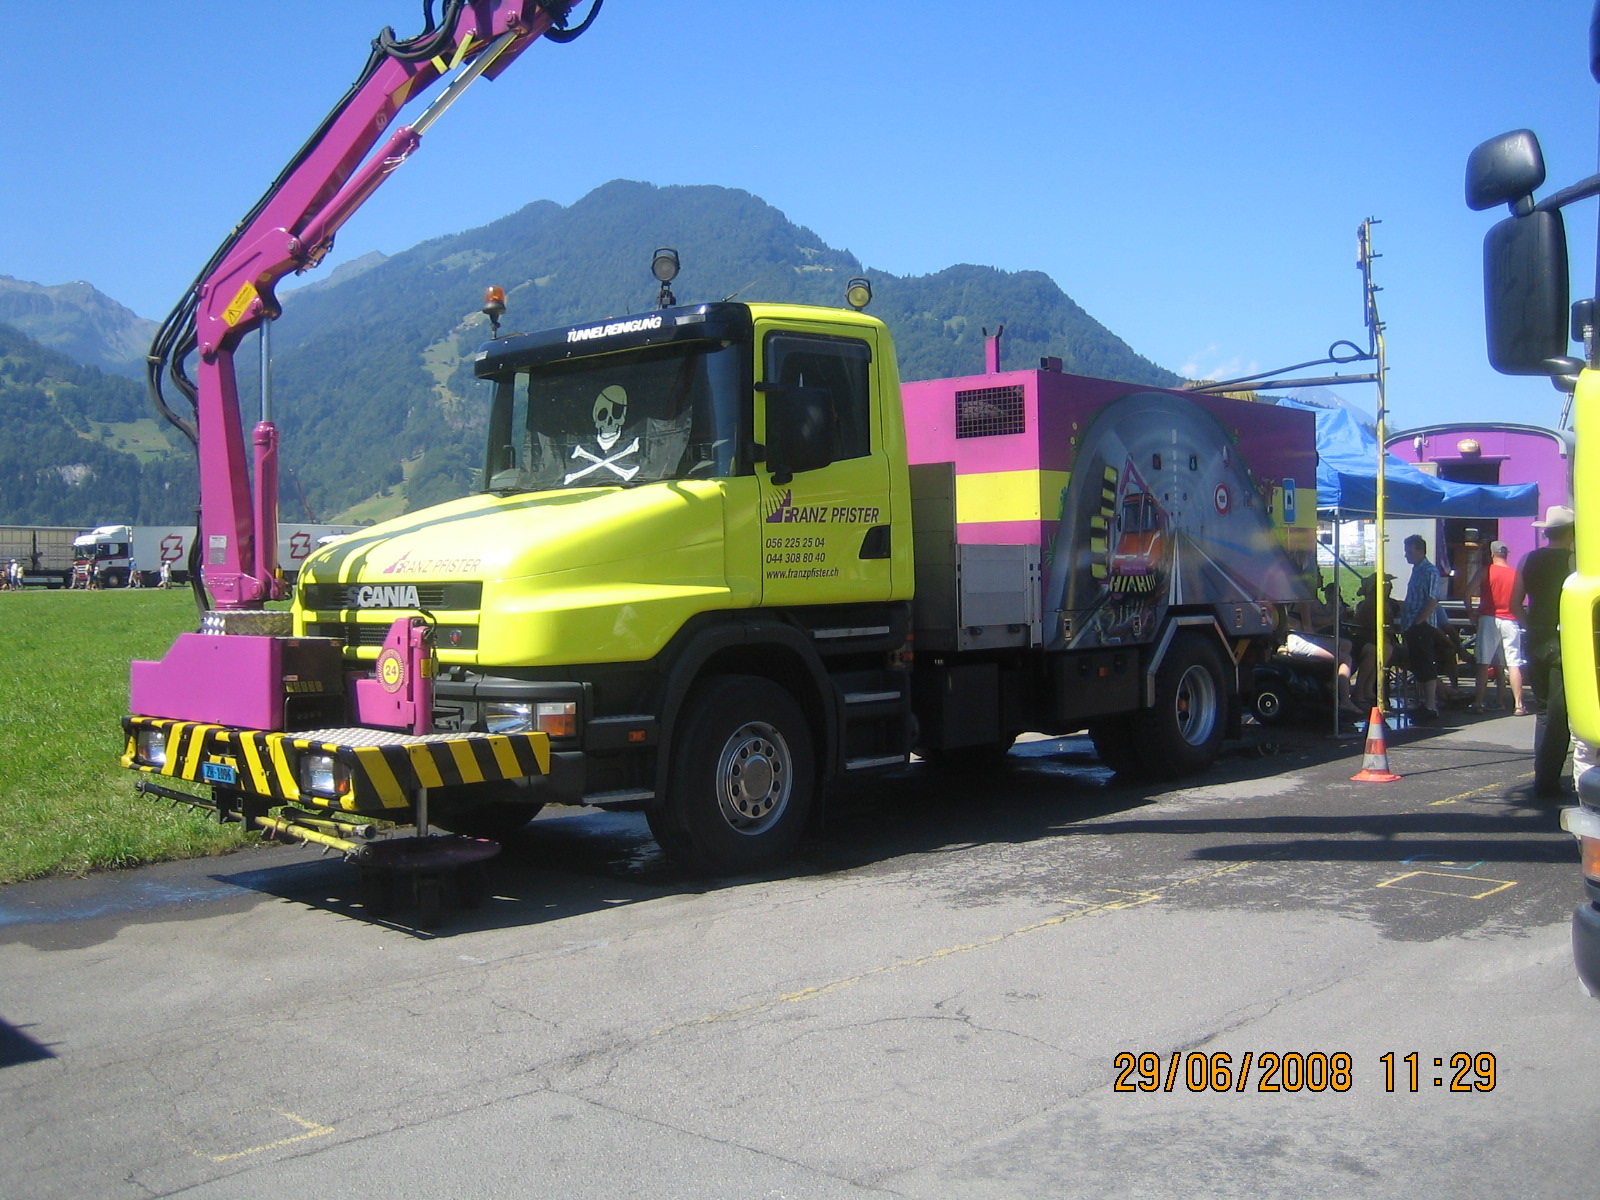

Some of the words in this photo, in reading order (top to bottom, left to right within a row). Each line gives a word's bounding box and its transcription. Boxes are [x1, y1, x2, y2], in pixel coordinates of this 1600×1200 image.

[566, 316, 662, 343] TUNNELREINIGUNG
[831, 507, 879, 523] PFISTER
[765, 538, 783, 549] 056
[784, 537, 801, 548] 225
[802, 537, 813, 548] 25
[814, 537, 825, 547] 04
[766, 553, 783, 564] 044
[785, 553, 801, 563] 308
[802, 552, 814, 563] 80
[815, 552, 826, 563] 40
[432, 558, 482, 573] PFISTER
[766, 567, 839, 580] www.franzpfister.ch
[347, 585, 421, 608] SCANIA
[385, 664, 397, 676] 24
